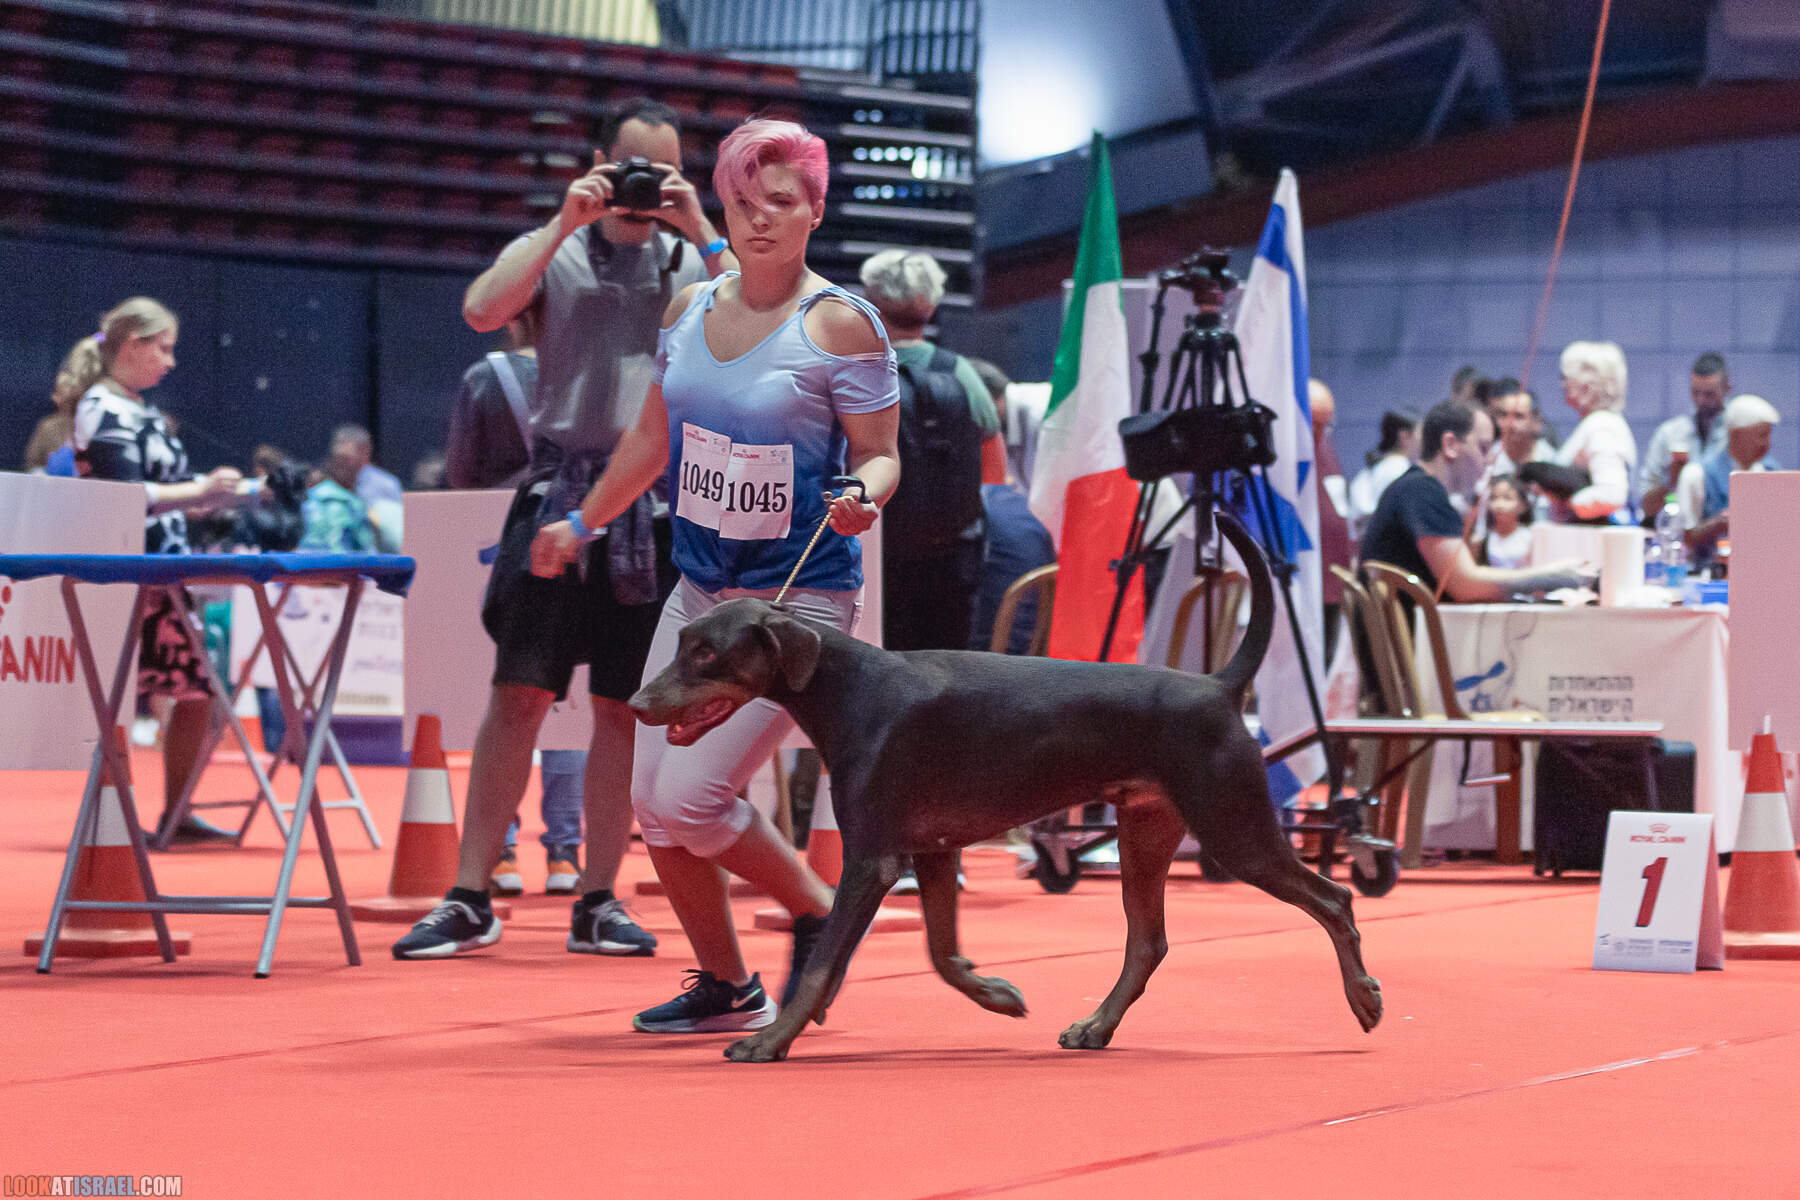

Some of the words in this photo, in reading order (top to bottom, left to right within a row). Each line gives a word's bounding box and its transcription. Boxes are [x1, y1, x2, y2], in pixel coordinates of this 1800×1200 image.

[682, 460, 724, 502] 1049
[726, 480, 788, 513] 1045
[0, 634, 77, 684] ANIN
[1548, 696, 1633, 713] הישראלית
[1635, 857, 1668, 927] 1
